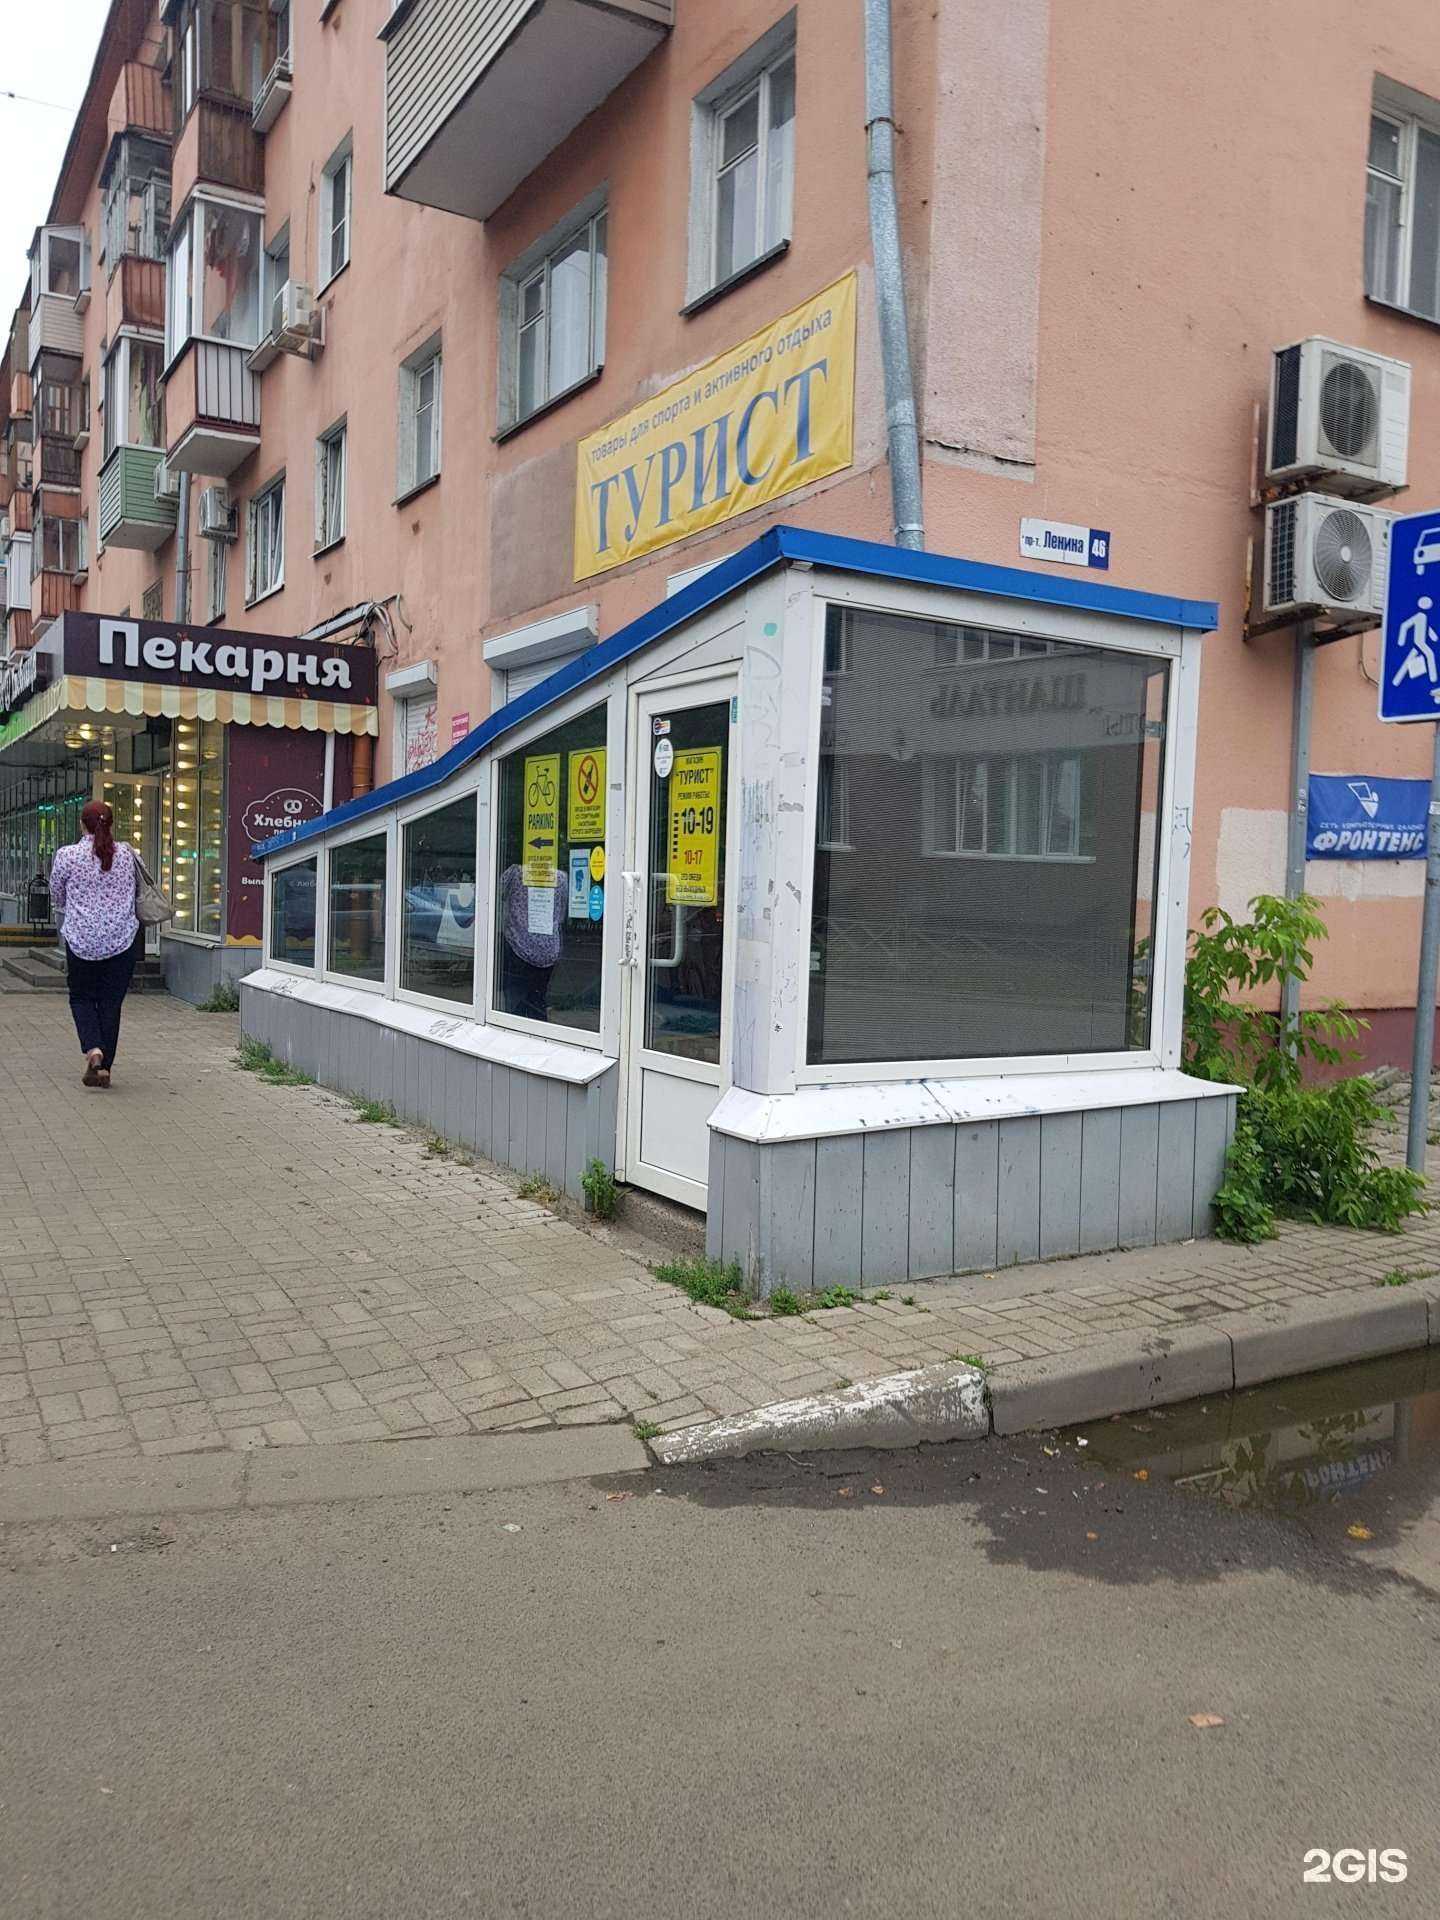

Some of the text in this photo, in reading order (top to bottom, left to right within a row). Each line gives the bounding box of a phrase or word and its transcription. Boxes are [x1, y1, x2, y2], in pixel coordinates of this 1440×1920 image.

[591, 309, 833, 463] товары для спорта и активного отдыха
[591, 358, 828, 554] ТУРИСТ
[1043, 530, 1084, 554] Ленина
[1091, 538, 1106, 558] 46
[100, 619, 351, 691] Пекарня
[528, 813, 554, 830] PARKING
[681, 806, 713, 834] 10-19
[684, 849, 703, 864] 10-17
